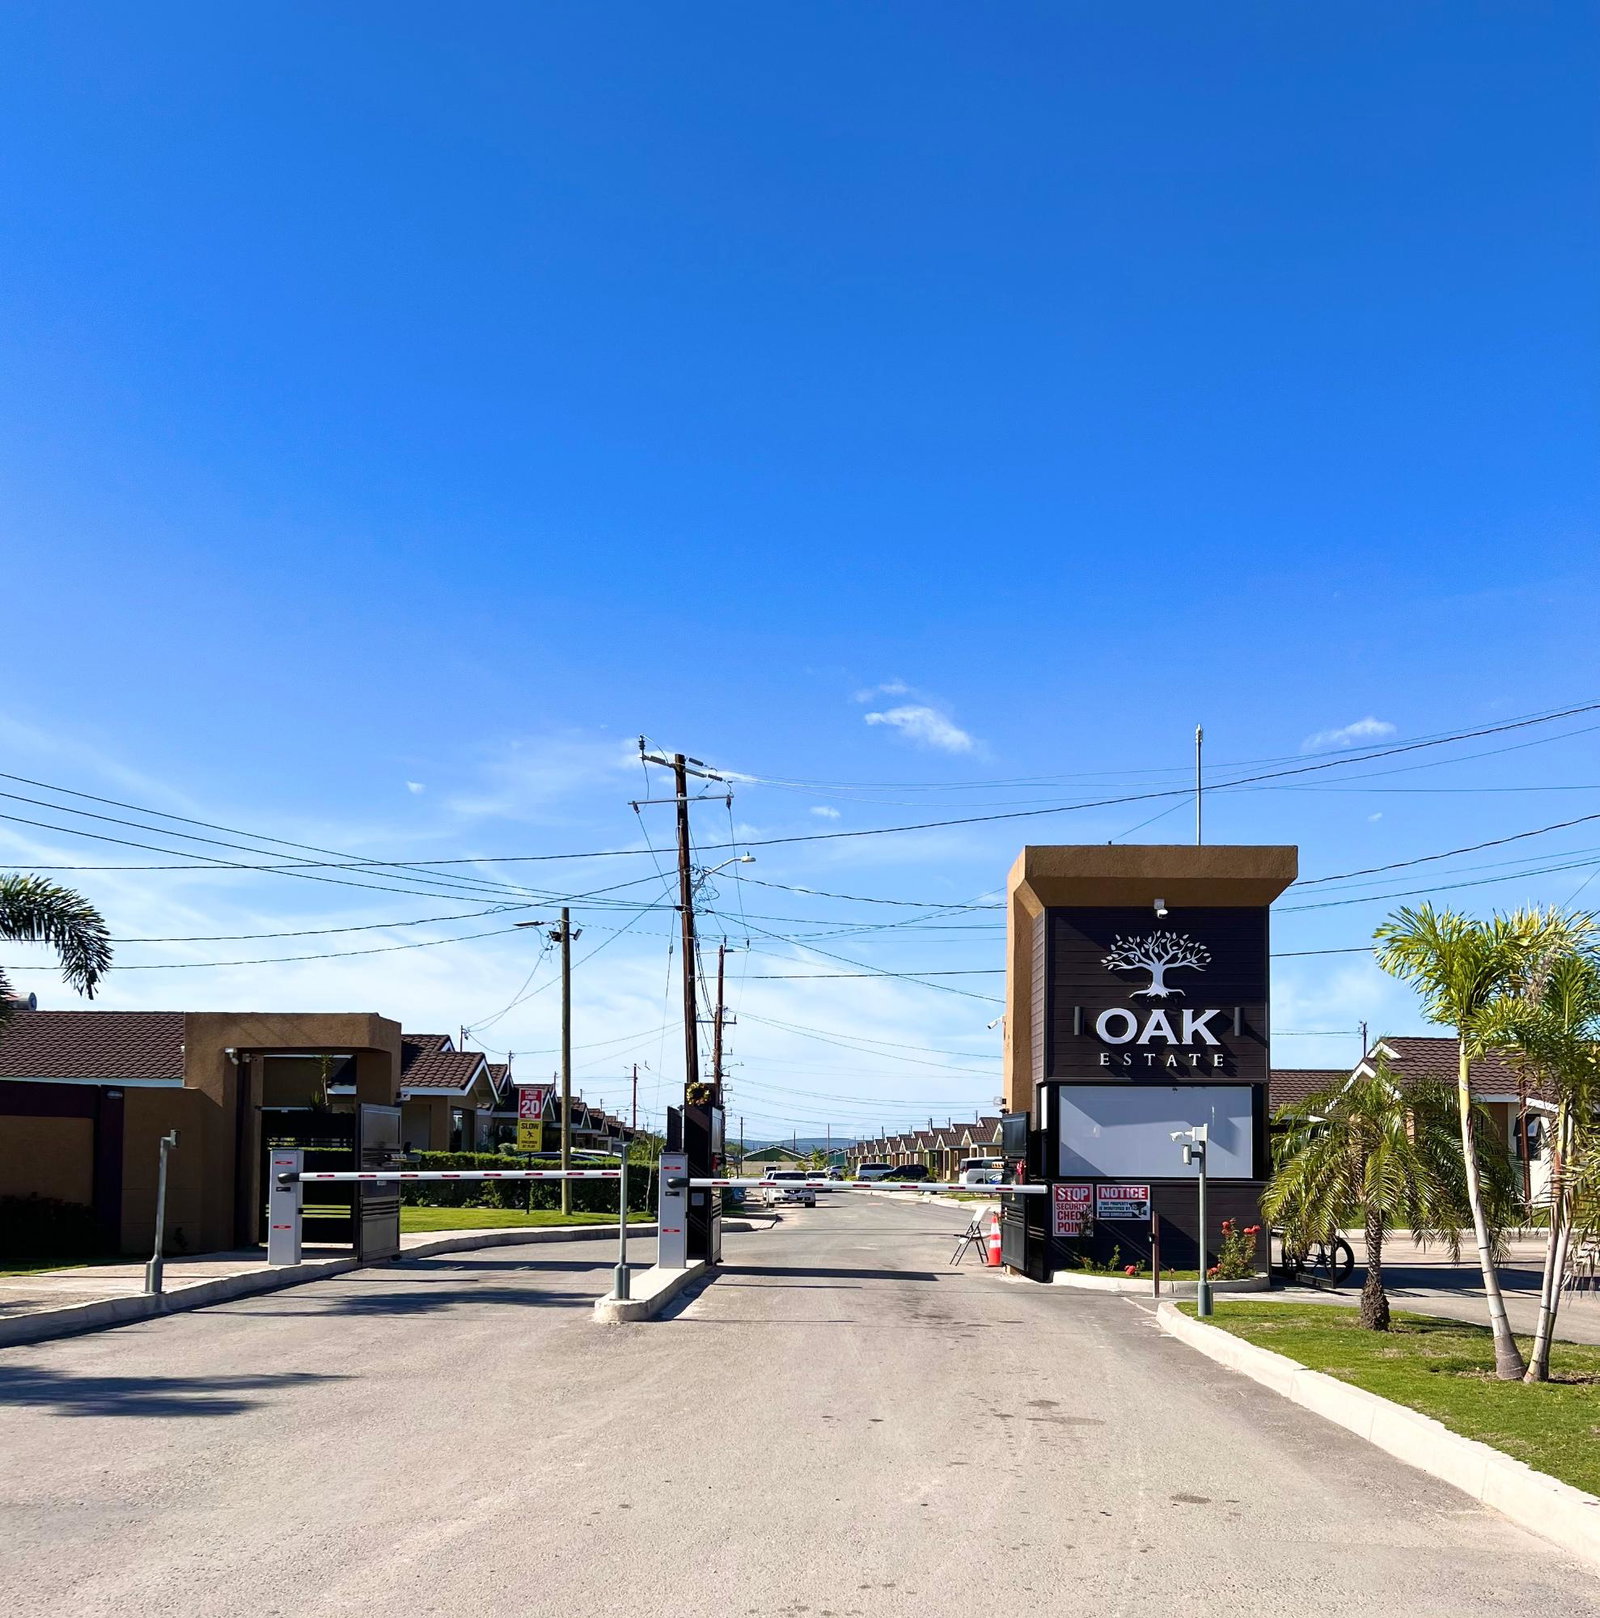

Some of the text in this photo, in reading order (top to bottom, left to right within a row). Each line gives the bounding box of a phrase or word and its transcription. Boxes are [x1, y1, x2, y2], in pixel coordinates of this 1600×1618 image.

[1095, 1007, 1222, 1046] OAK
[1099, 1053, 1224, 1067] ESTATE
[521, 1100, 540, 1114] 20
[1057, 1187, 1089, 1201] STOP
[1100, 1187, 1146, 1199] NOTICE
